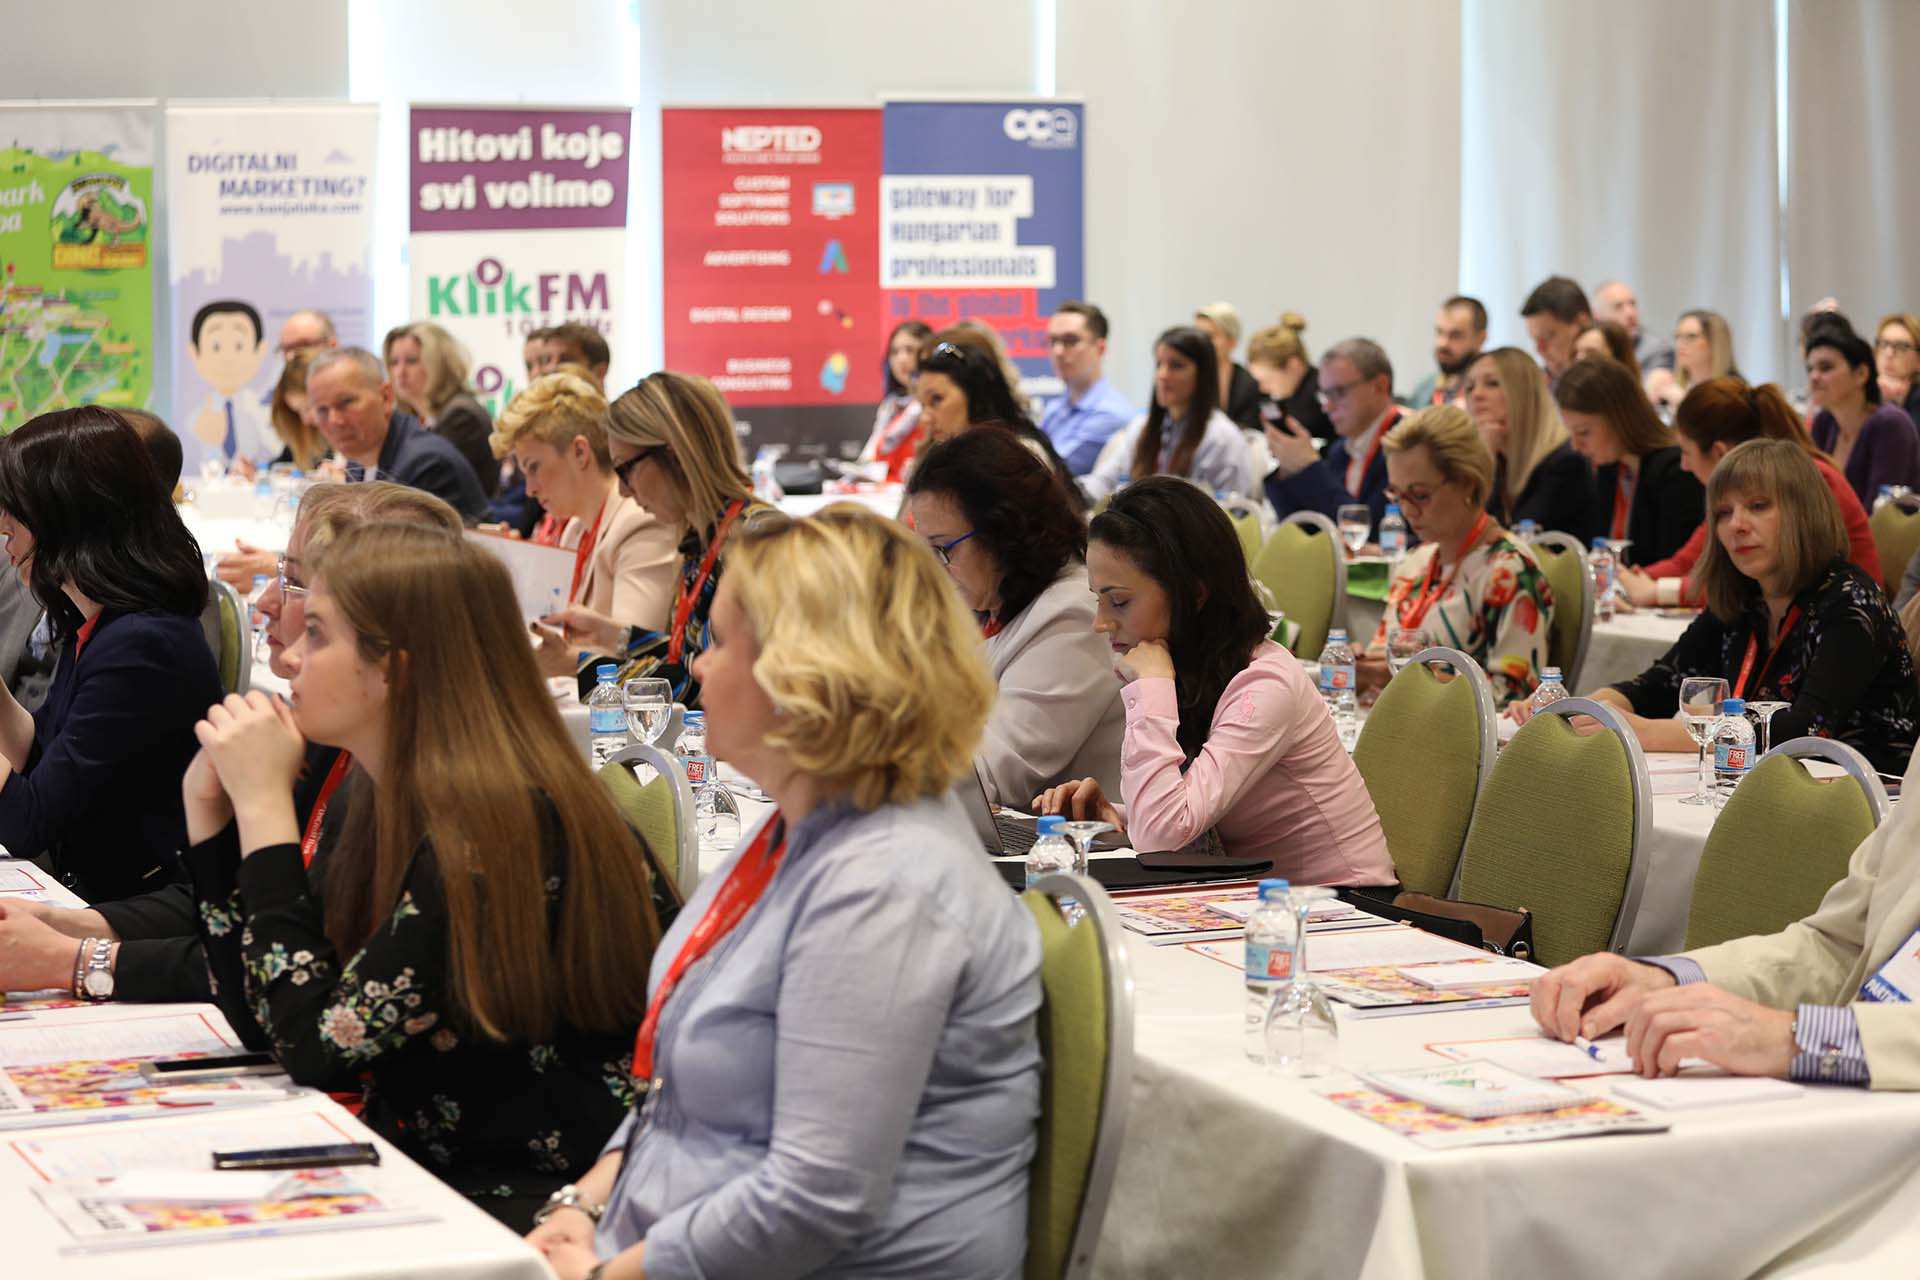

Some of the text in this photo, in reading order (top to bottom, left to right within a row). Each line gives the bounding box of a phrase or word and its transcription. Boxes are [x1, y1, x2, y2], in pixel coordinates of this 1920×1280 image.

[418, 123, 624, 168] Hitovi koje
[721, 126, 822, 151] NEPTED
[188, 154, 297, 173] DIGITALNI
[219, 176, 367, 197] MARKETING?
[419, 171, 615, 210] svi volimo
[891, 185, 1015, 209] gateway for
[891, 255, 1037, 278] professionals
